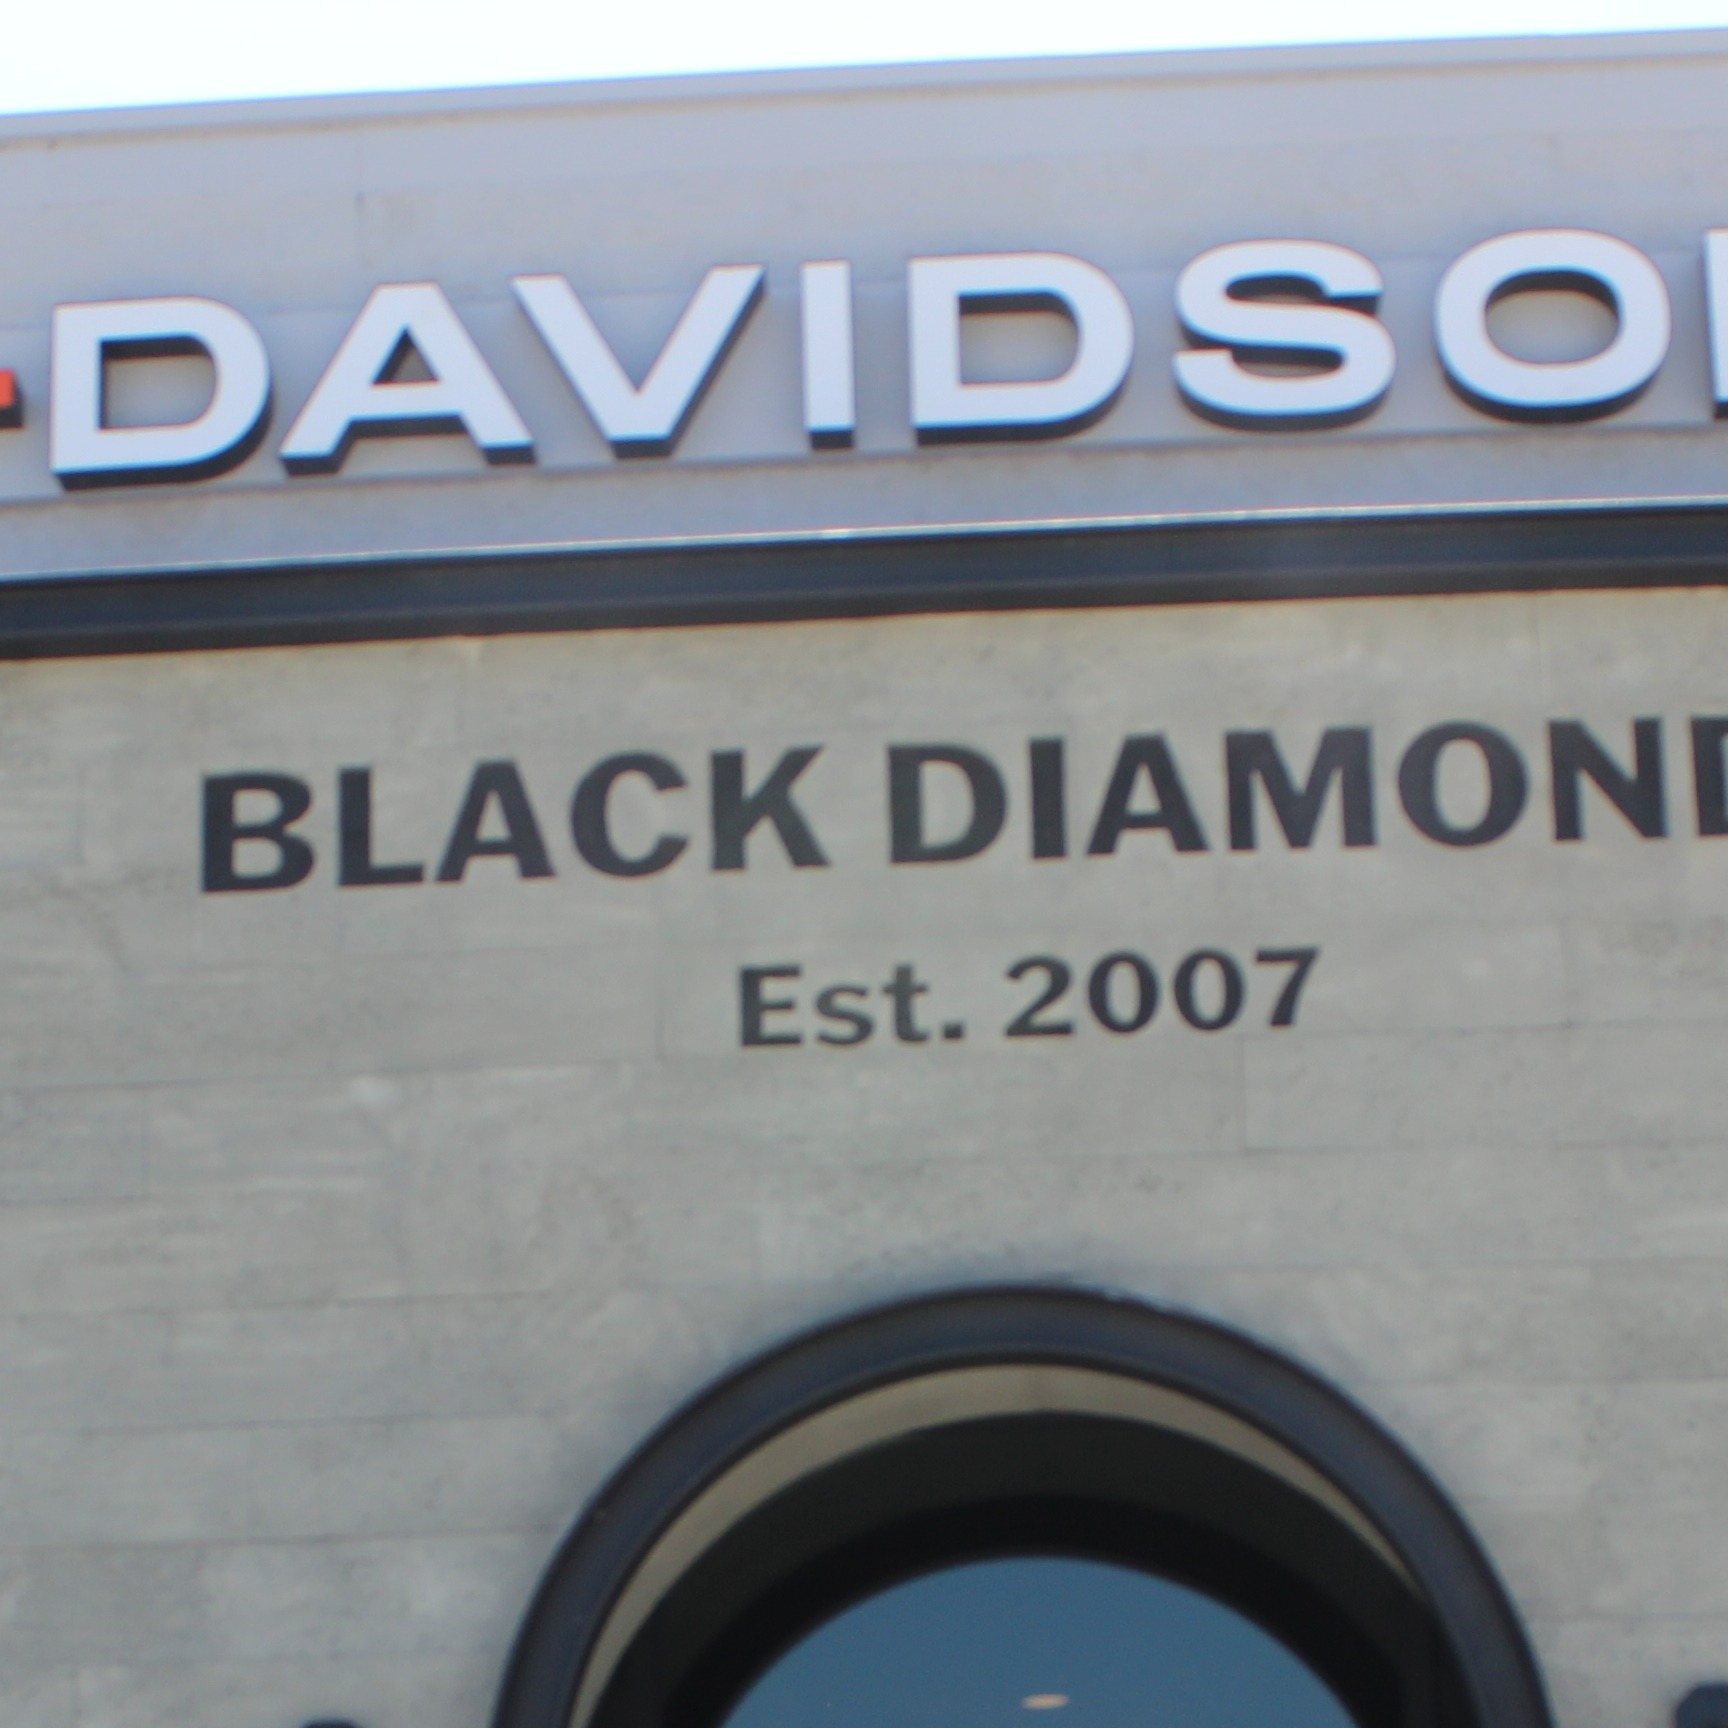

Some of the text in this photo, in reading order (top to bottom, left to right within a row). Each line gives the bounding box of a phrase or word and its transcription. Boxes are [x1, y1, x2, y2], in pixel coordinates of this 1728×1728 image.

[200, 745, 829, 893] BLACK
[739, 950, 1318, 1047] Est. 2007
